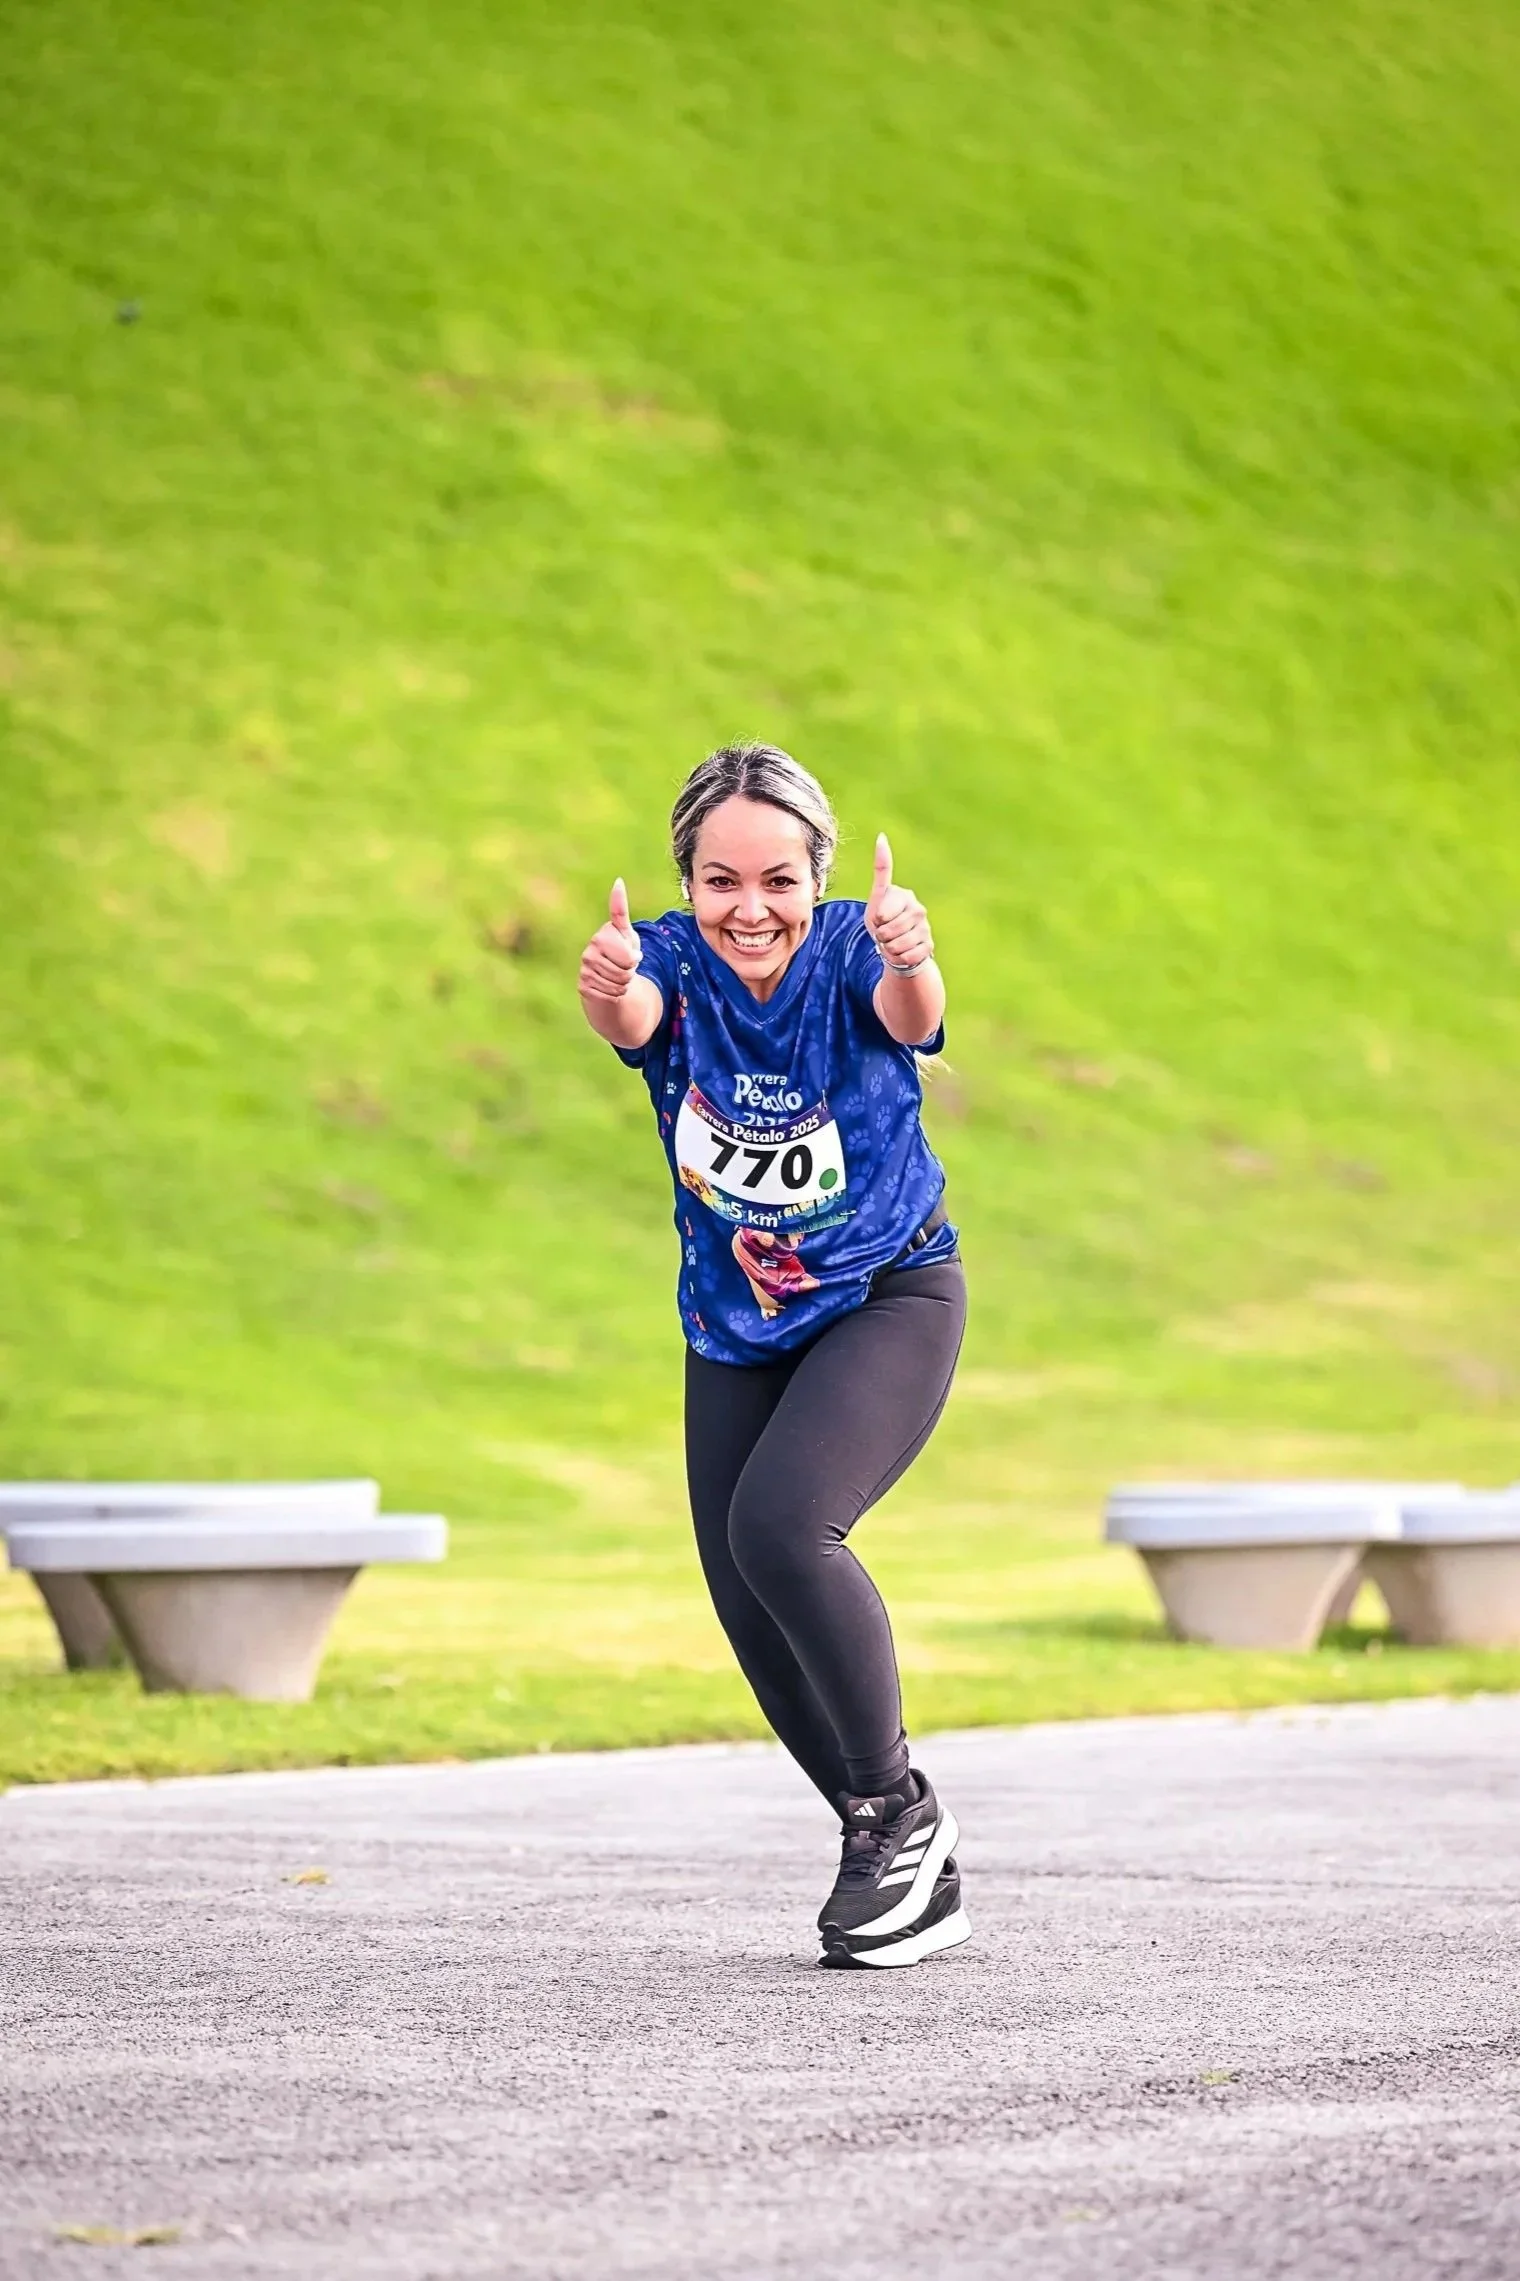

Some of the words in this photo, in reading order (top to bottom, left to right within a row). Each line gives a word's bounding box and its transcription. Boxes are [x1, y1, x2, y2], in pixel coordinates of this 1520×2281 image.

[697, 1103, 729, 1133] Carrera
[731, 1123, 785, 1143] Pétalo
[790, 1114, 820, 1139] 2025
[708, 1131, 813, 1190] 770
[729, 1201, 743, 1220] 5
[747, 1209, 778, 1228] km
